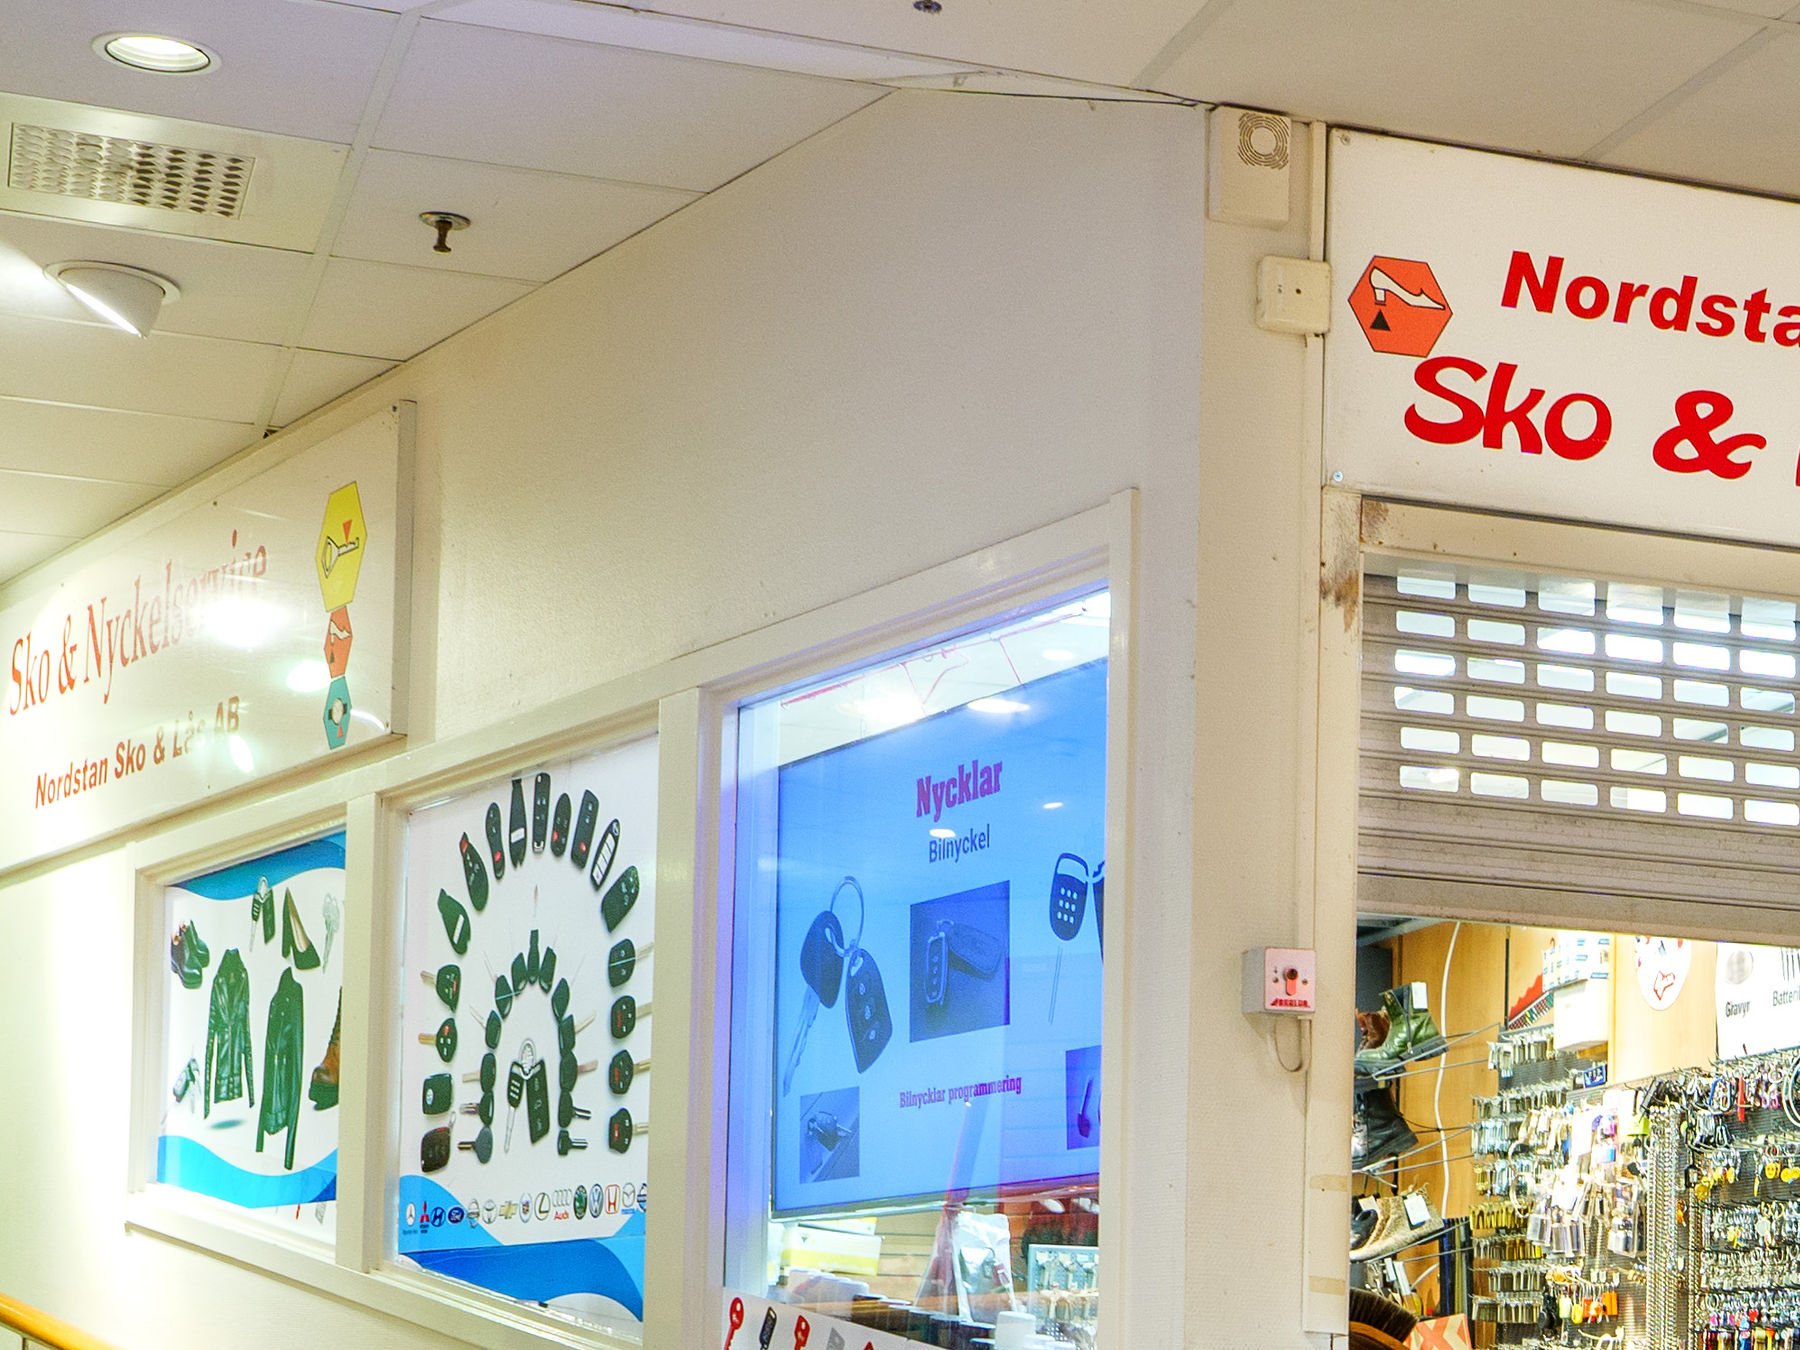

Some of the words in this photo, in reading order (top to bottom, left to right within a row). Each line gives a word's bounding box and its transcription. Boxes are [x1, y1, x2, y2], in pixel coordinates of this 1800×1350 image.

[1403, 355, 1613, 462] Sko
[1652, 388, 1768, 480] &
[10, 632, 51, 716] Sko
[58, 614, 78, 695] &
[35, 756, 109, 809] Nordstan
[114, 738, 147, 780] Sko
[153, 725, 166, 765] &
[214, 695, 240, 735] AB
[915, 759, 1003, 823] Nycklar
[929, 823, 990, 864] Bilnyckel
[1725, 1001, 1751, 1018] Gravyr
[948, 1074, 1022, 1105] programmering
